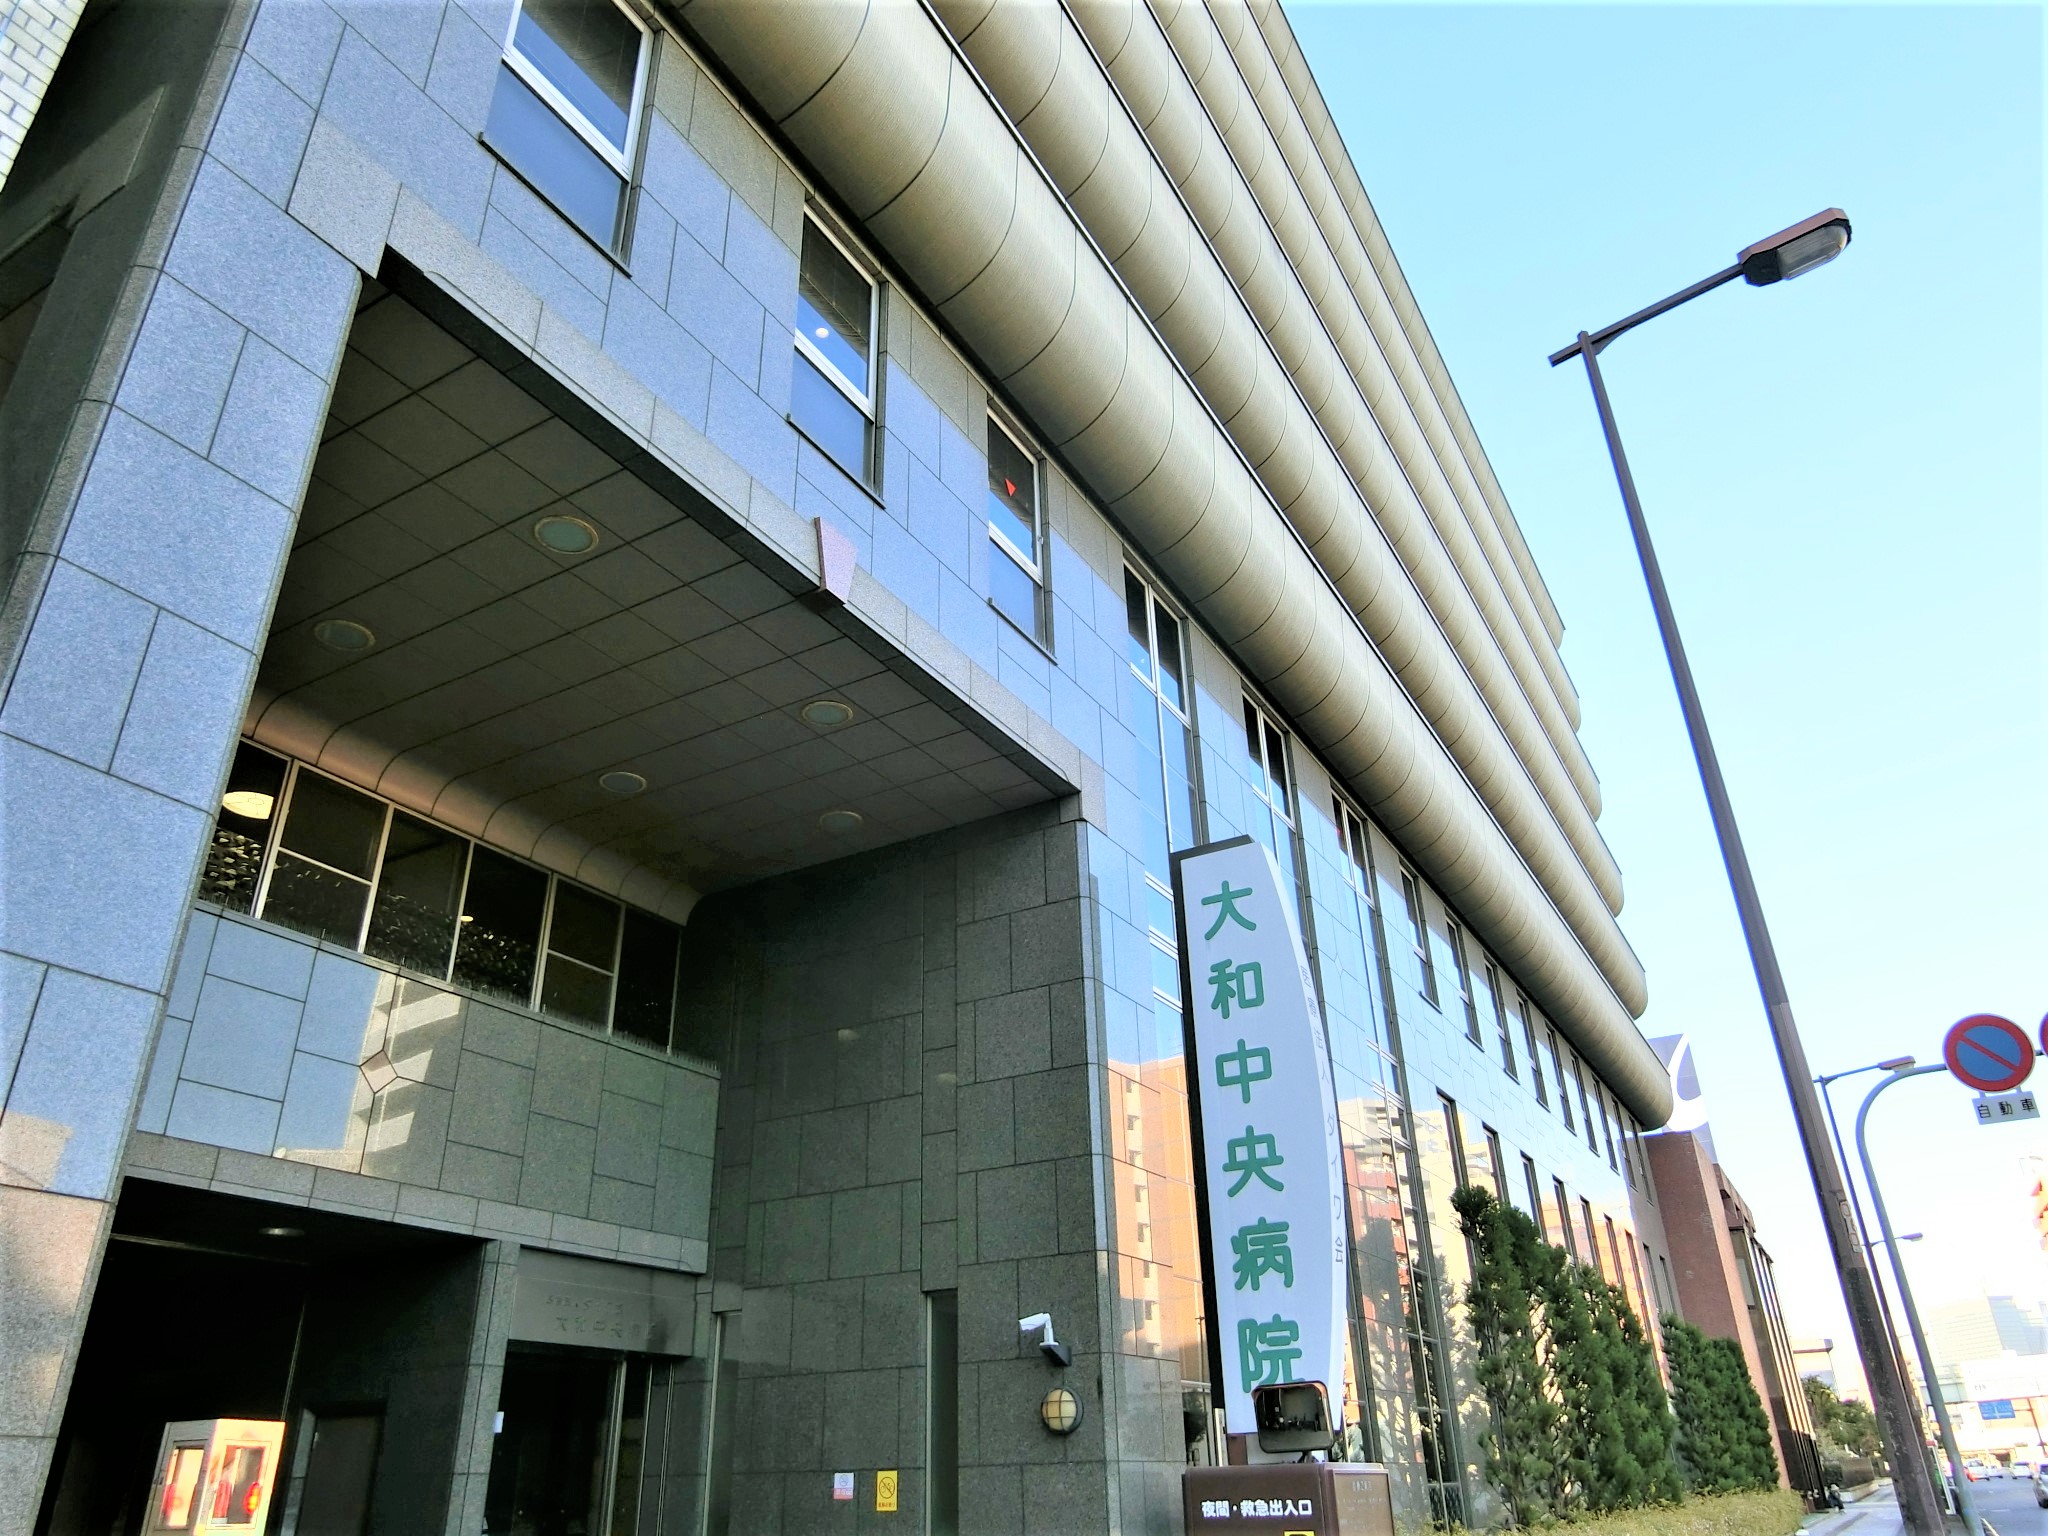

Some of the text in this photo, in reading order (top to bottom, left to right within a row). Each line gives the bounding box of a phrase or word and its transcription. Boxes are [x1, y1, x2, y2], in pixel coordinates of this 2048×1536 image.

[1977, 1098, 2035, 1118] 自動車
[1201, 880, 1305, 1394] 大和中央病院
[1201, 1499, 1313, 1518] 夜間・救急出入口
